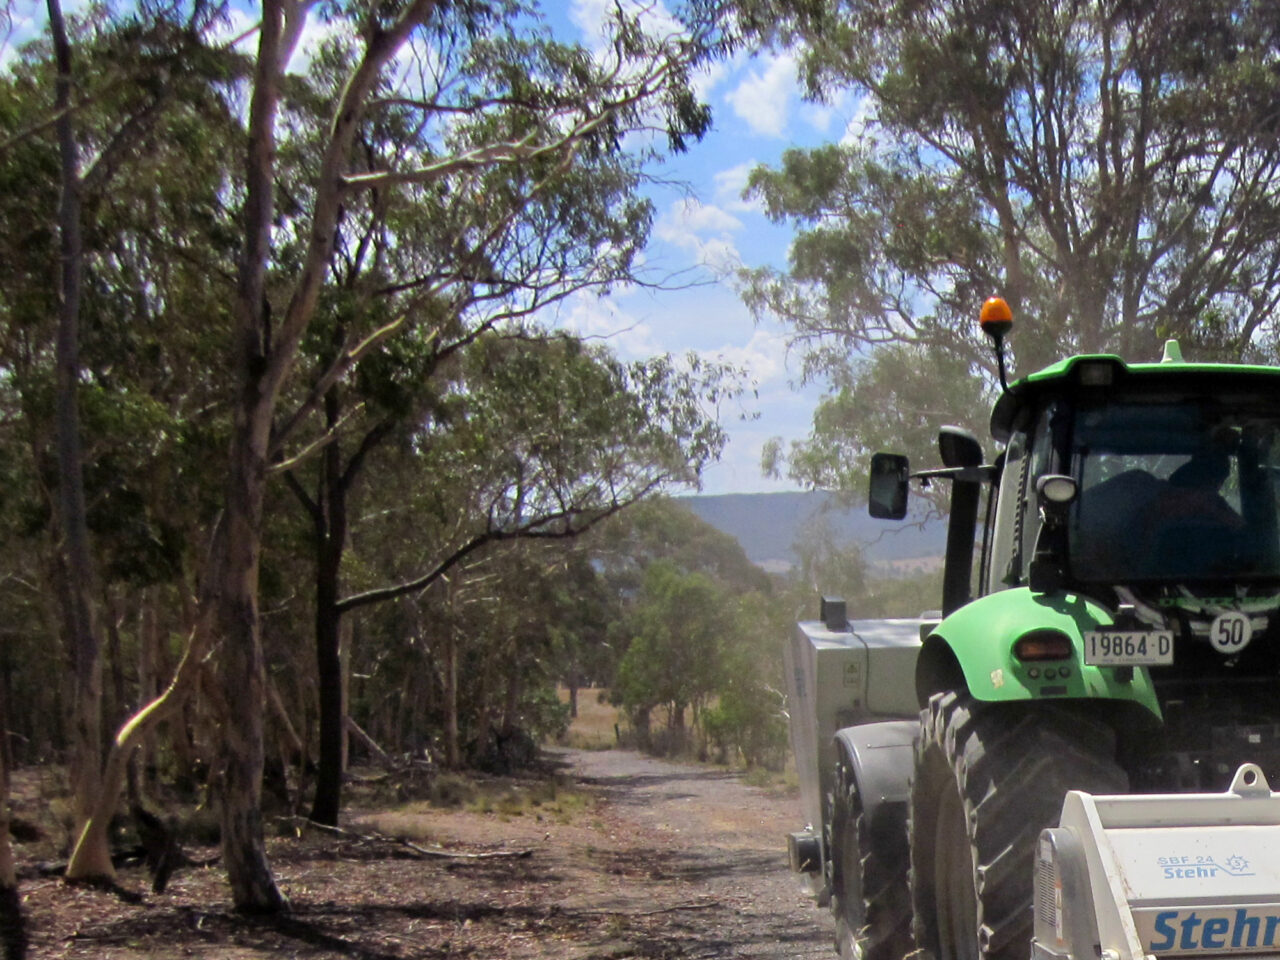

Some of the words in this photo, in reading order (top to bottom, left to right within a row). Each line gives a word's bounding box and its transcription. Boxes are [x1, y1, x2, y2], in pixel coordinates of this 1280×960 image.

[1218, 619, 1244, 646] 50
[1157, 856, 1189, 865] SBF
[1196, 855, 1214, 863] 24
[1164, 866, 1218, 879] Stehr
